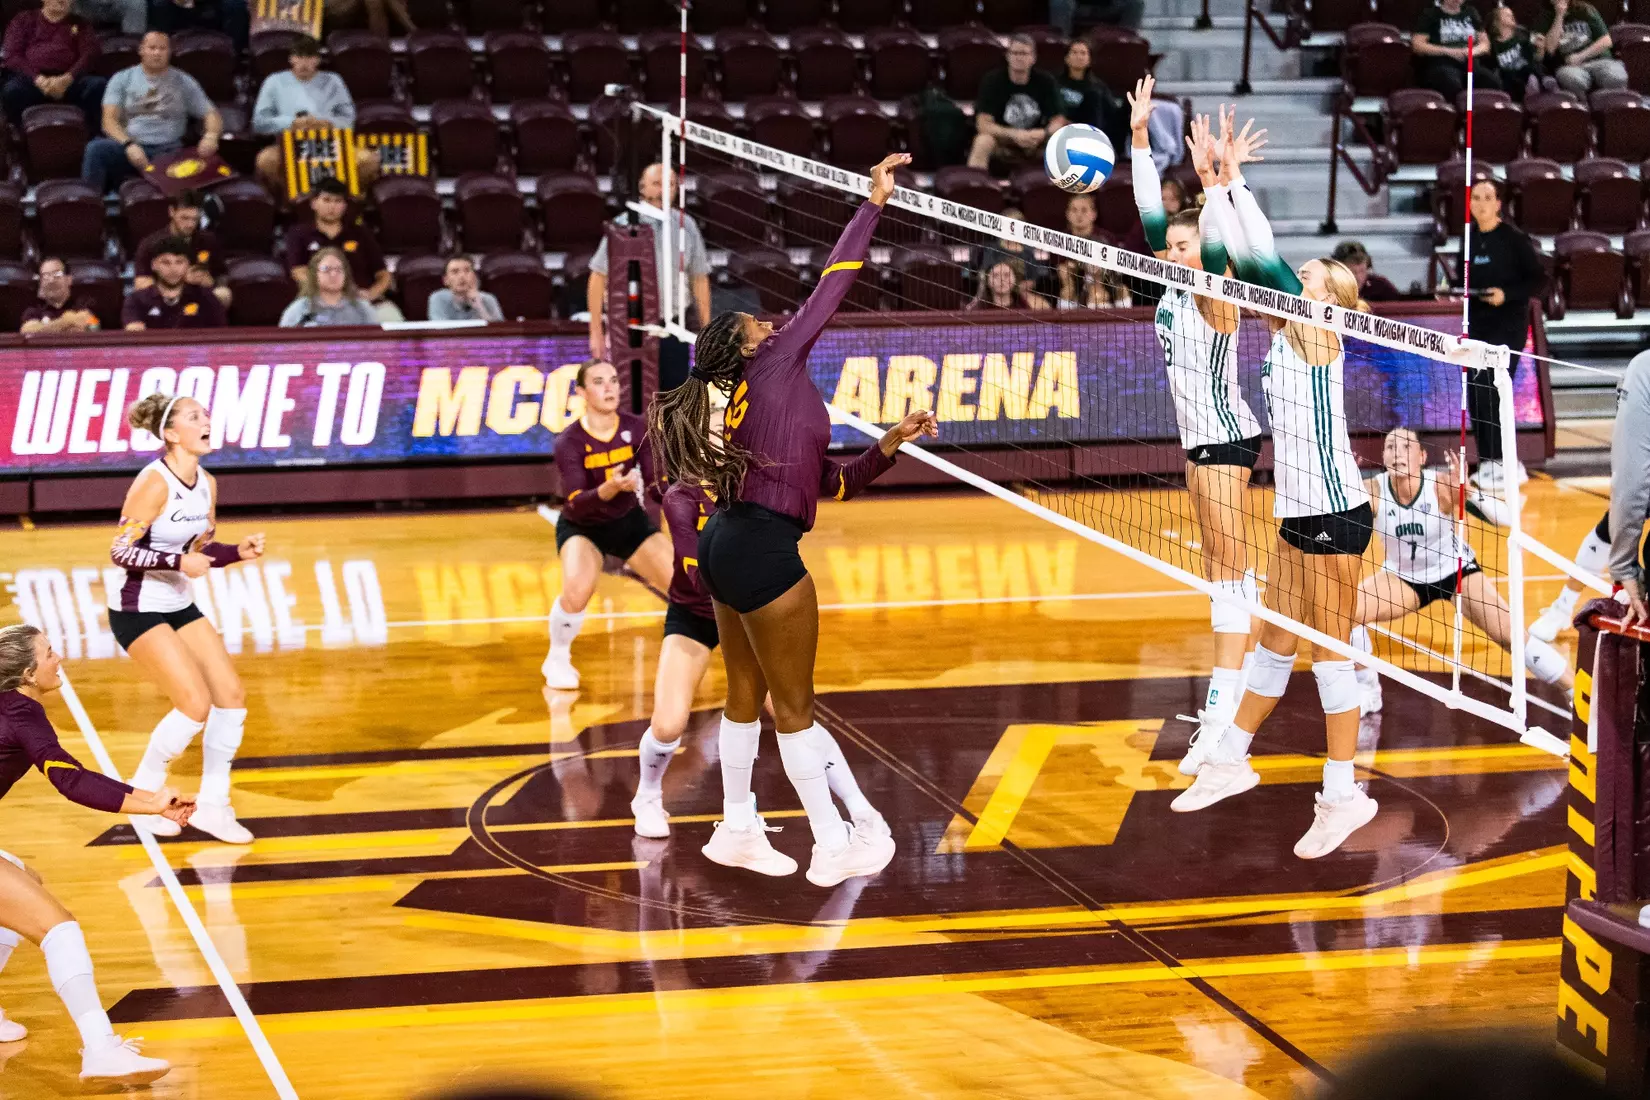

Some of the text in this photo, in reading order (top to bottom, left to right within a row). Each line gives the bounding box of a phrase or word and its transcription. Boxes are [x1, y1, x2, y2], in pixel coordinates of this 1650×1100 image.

[1043, 230, 1065, 250] MICHIGAN
[1065, 236, 1093, 258] VOLLEYBALL
[1116, 250, 1195, 287] CENTRAL MICHIGAN VOLLEYBALL
[1222, 279, 1313, 320] CENTRAL MICHIGAN VOLLEYBALL
[1344, 311, 1446, 355] CENTRAL MICHIGAN VOLLEYBALL
[312, 361, 387, 447] TO
[830, 351, 1081, 425] ARENA
[1395, 522, 1425, 538] OHIO
[110, 546, 161, 568] PPEWAS
[1406, 541, 1418, 561] 7
